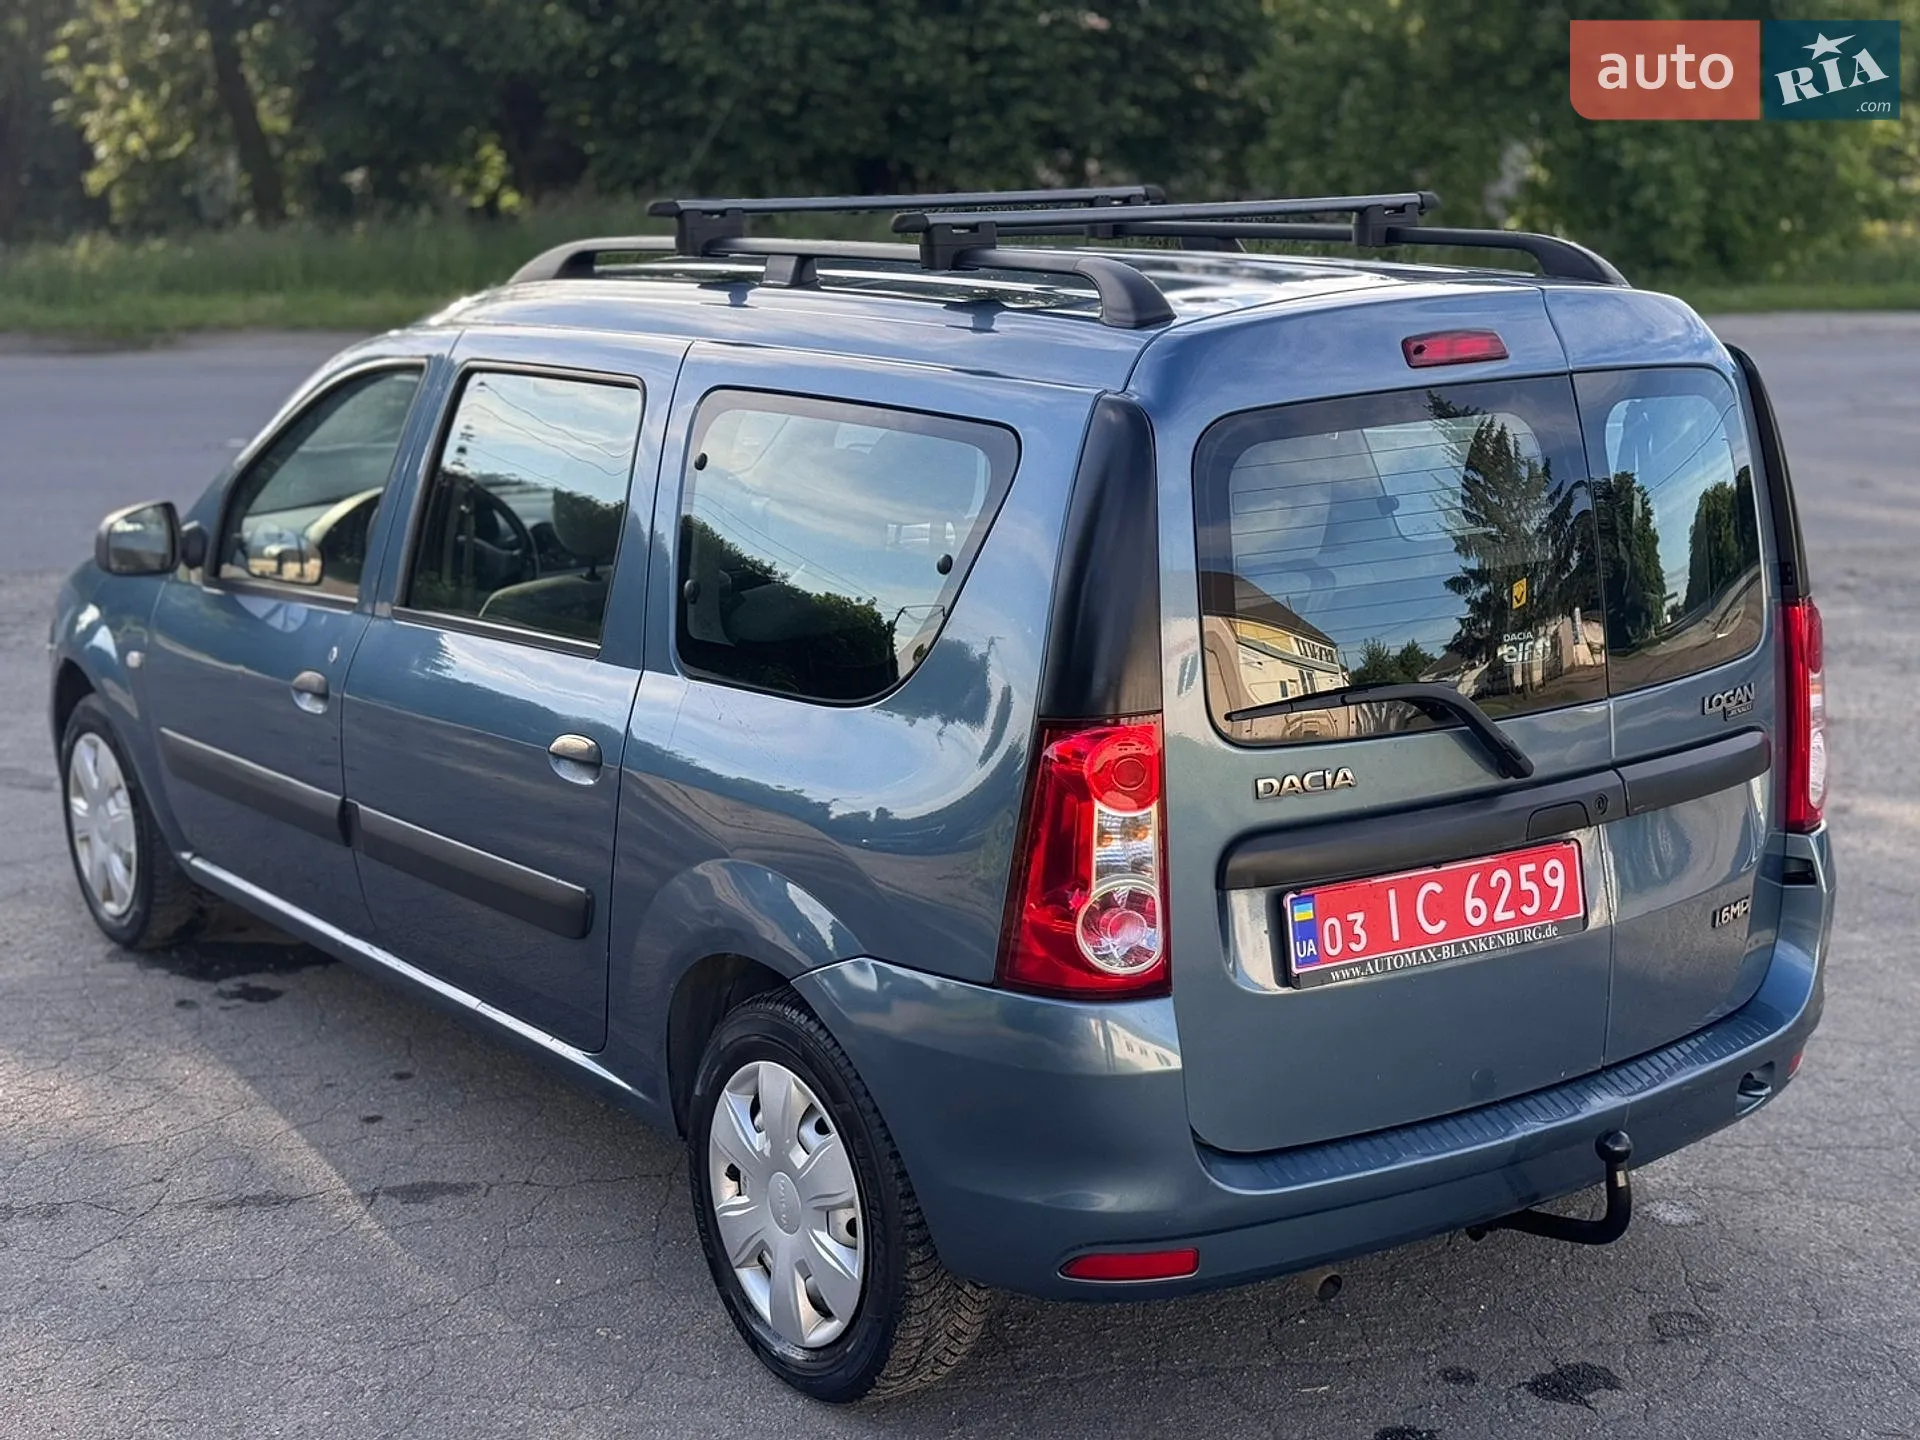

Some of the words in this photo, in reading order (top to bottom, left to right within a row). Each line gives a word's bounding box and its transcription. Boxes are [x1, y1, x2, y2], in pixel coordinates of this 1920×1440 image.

[1702, 682, 1755, 715] LOGAN
[1256, 767, 1356, 799] DACIA
[1322, 911, 1368, 956] 03
[1388, 881, 1447, 943] IC
[1464, 858, 1566, 926] 6259
[1296, 941, 1317, 958] UA
[1330, 924, 1558, 982] www.AUTOMAX-BLANKENBURG.de
